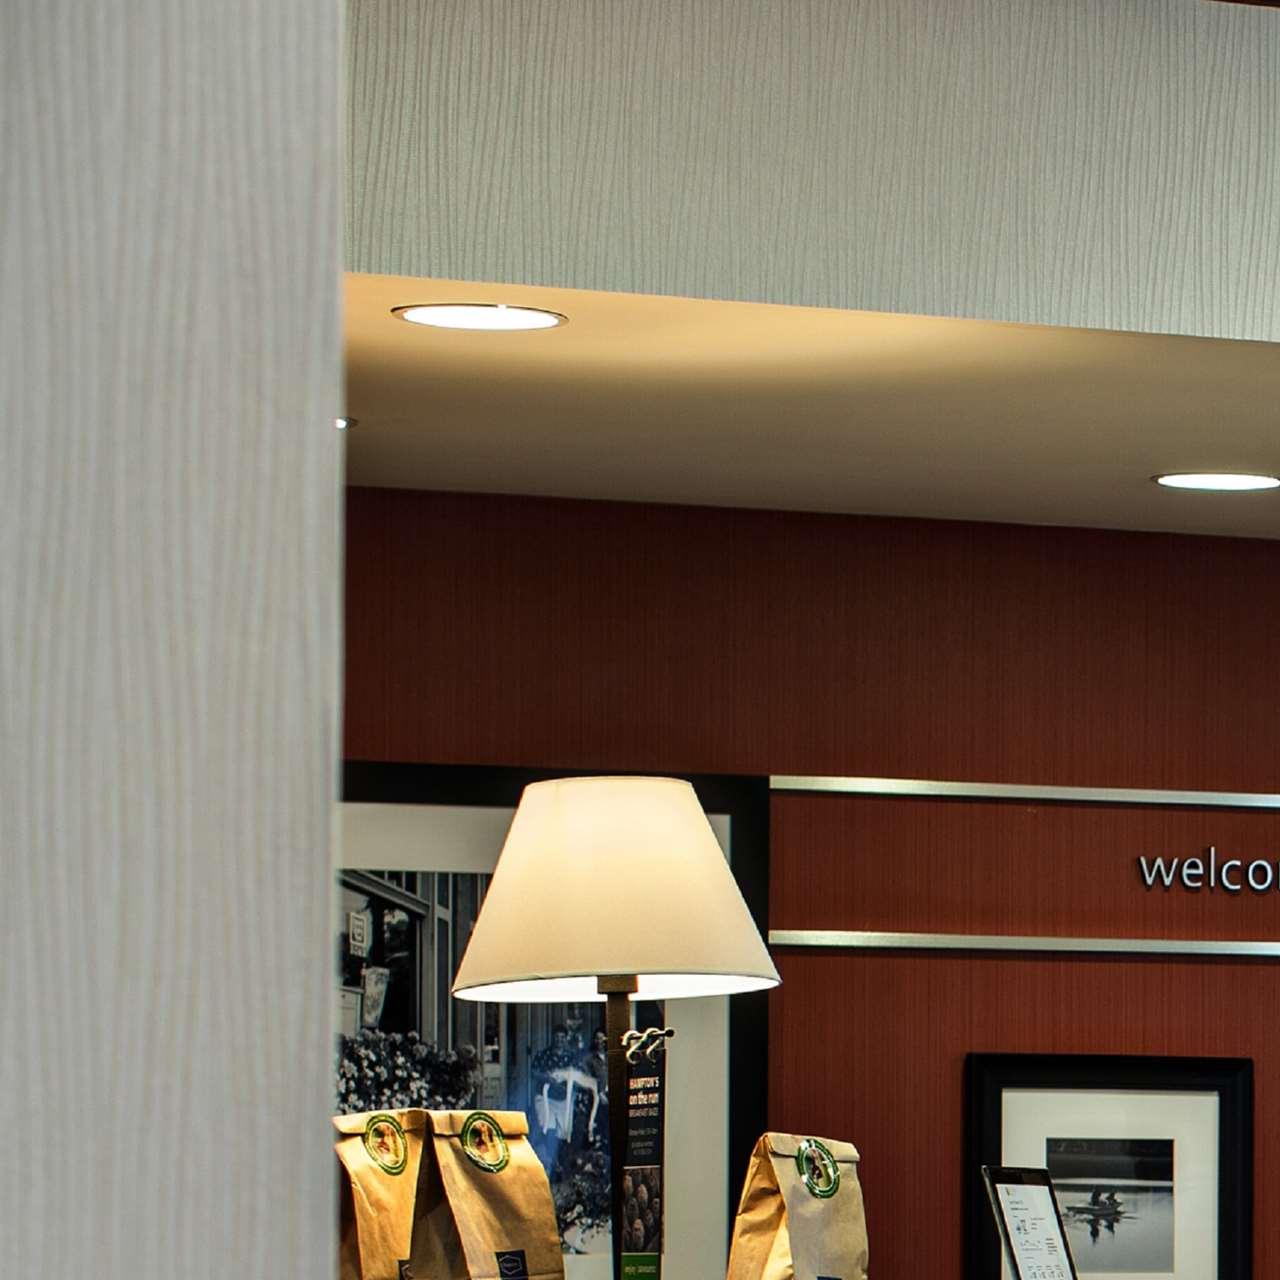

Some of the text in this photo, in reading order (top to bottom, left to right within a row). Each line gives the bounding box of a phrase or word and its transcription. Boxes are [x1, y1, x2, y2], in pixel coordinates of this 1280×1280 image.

[628, 1076, 660, 1089] HAMPTON'S
[628, 1091, 660, 1105] on the run
